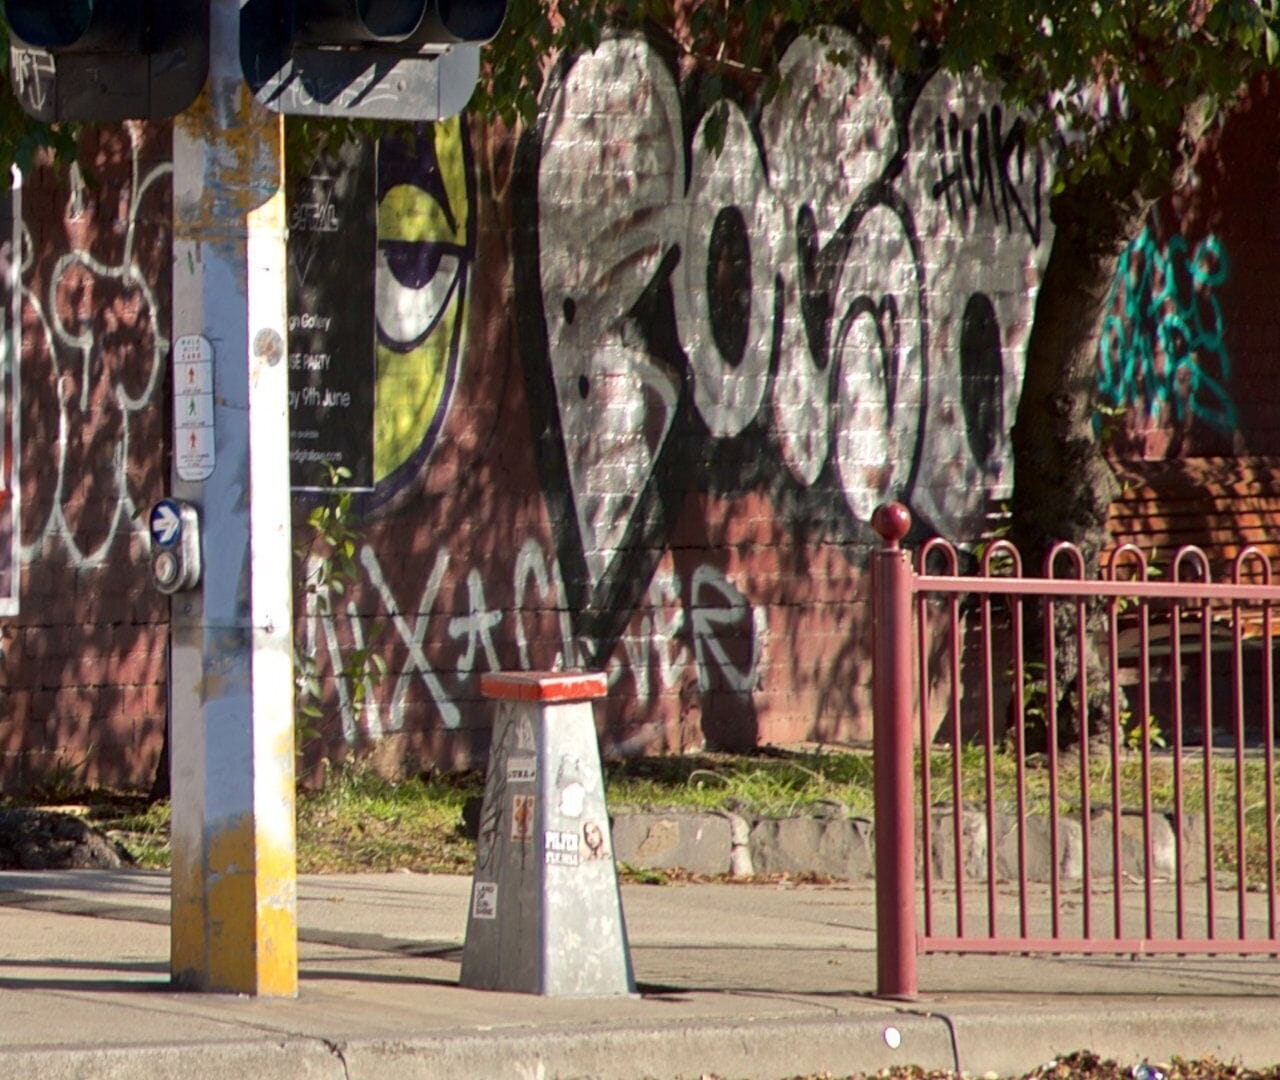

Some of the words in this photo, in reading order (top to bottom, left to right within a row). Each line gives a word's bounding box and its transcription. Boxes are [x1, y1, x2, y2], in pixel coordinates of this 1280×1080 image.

[303, 352, 332, 370] PARTY
[302, 386, 321, 407] 9th
[322, 387, 352, 408] June
